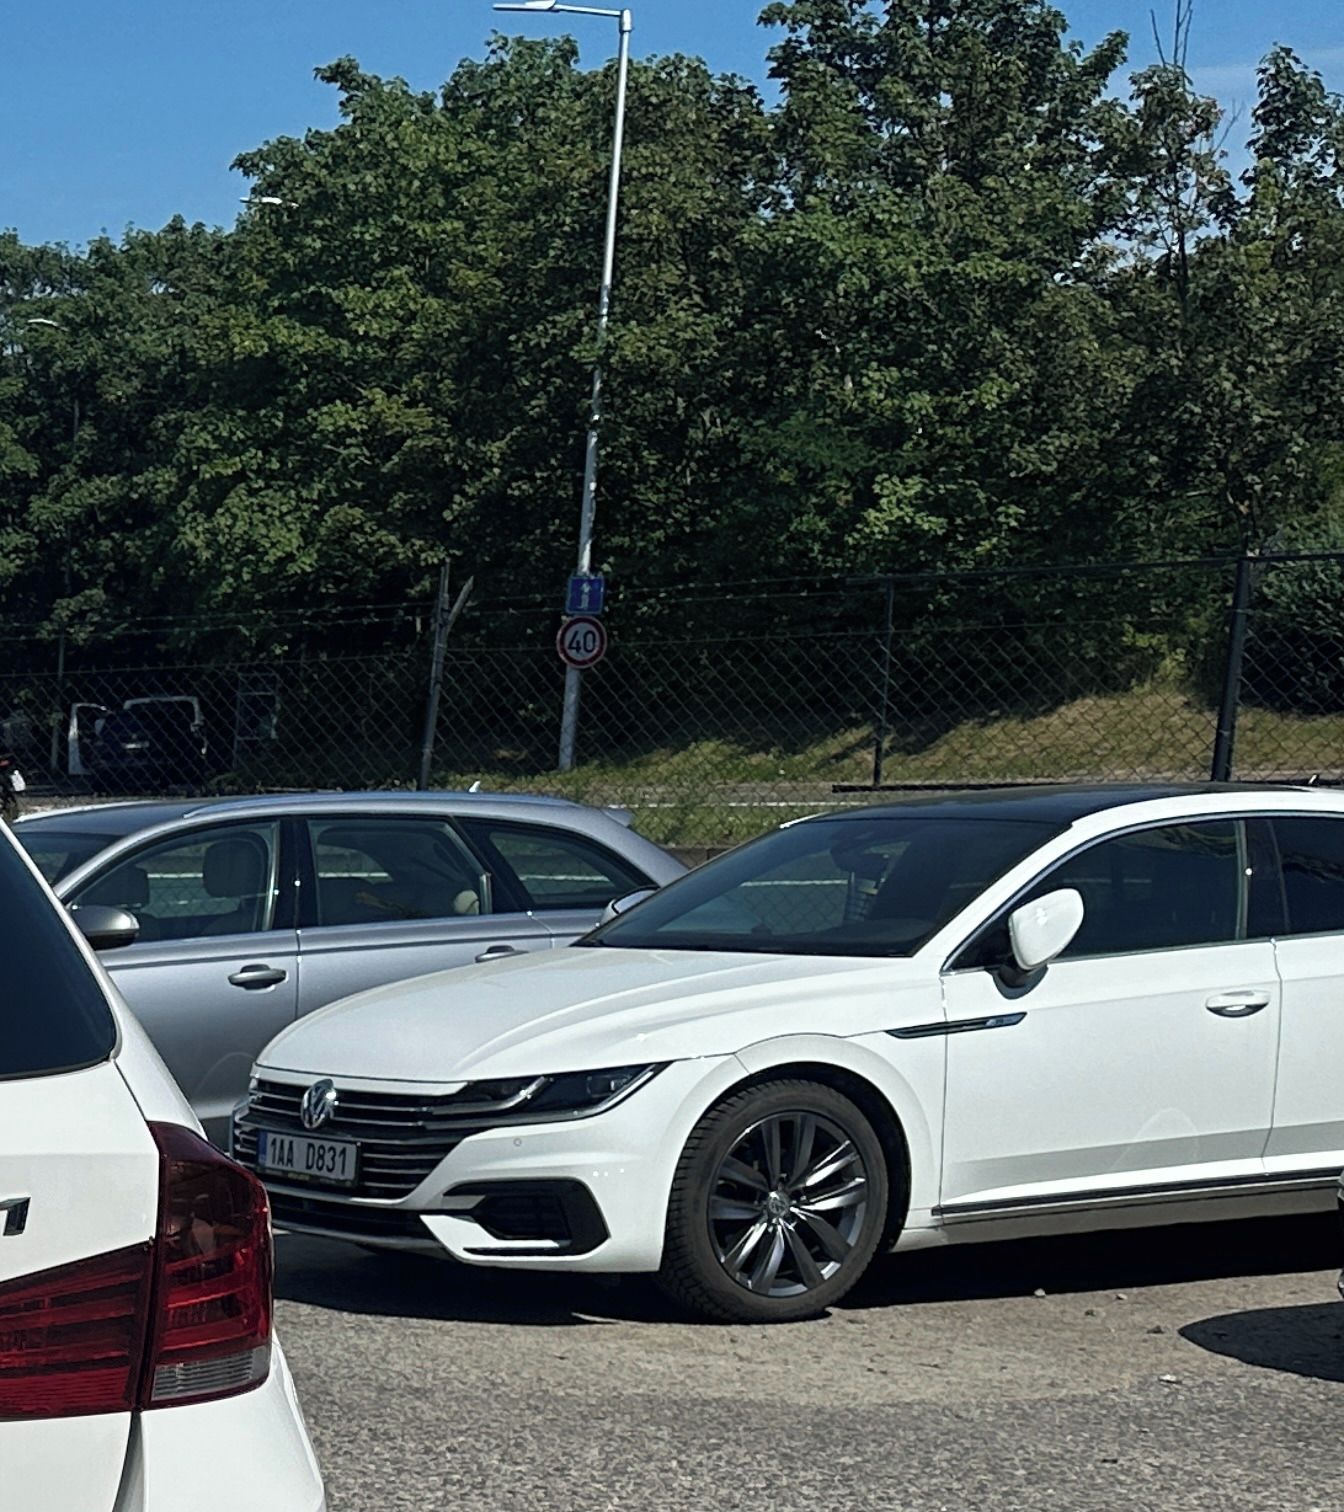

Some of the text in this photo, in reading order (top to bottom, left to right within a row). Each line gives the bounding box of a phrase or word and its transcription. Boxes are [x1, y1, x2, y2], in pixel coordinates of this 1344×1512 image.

[567, 630, 597, 654] 40
[270, 1137, 348, 1177] 1AA D831
